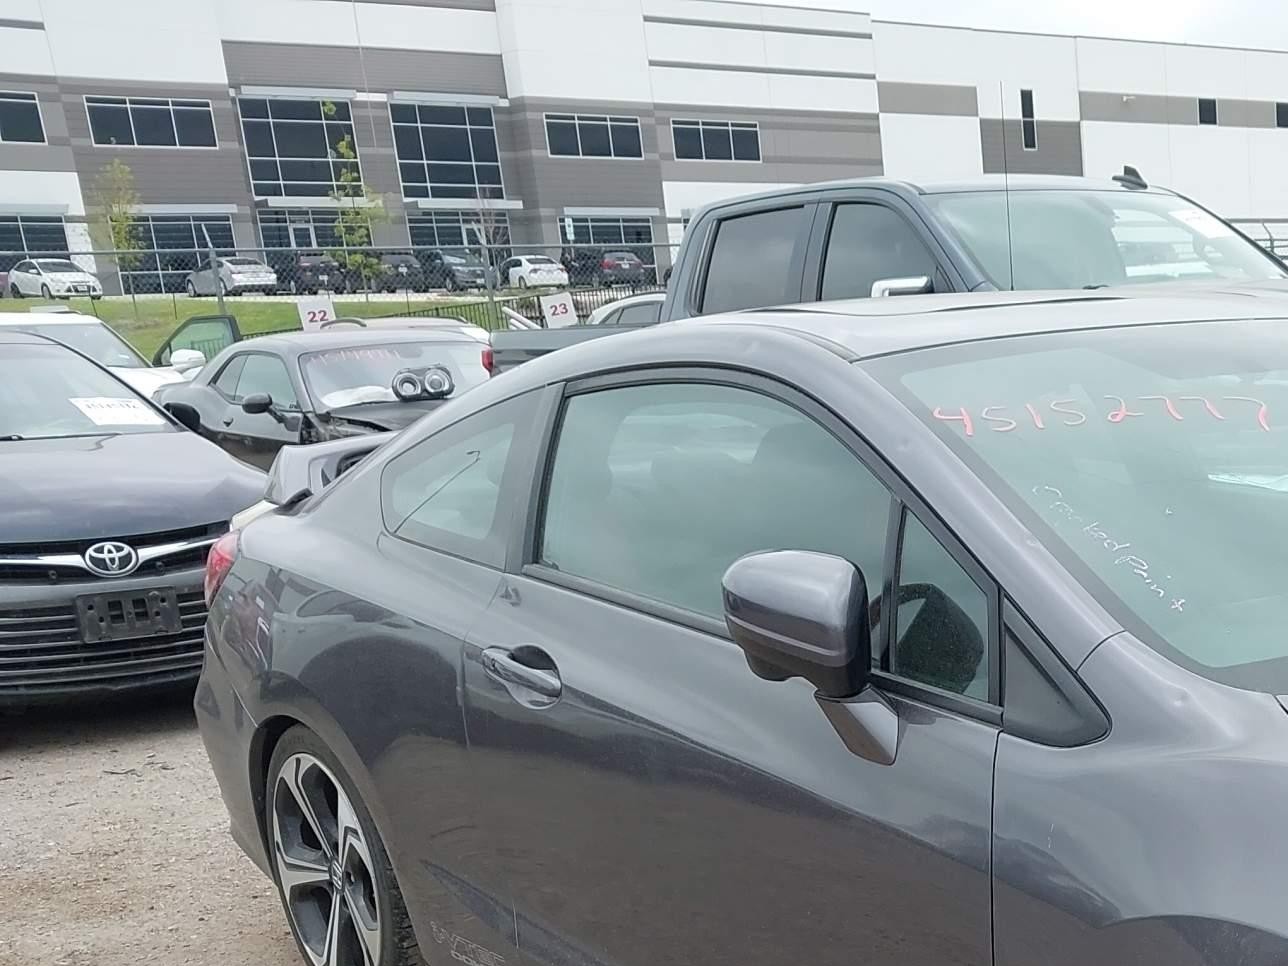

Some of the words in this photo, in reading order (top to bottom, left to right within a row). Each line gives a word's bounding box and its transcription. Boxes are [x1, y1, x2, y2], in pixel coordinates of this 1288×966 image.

[307, 310, 328, 322] 22
[550, 303, 568, 316] 23
[933, 395, 1270, 436] 45152777
